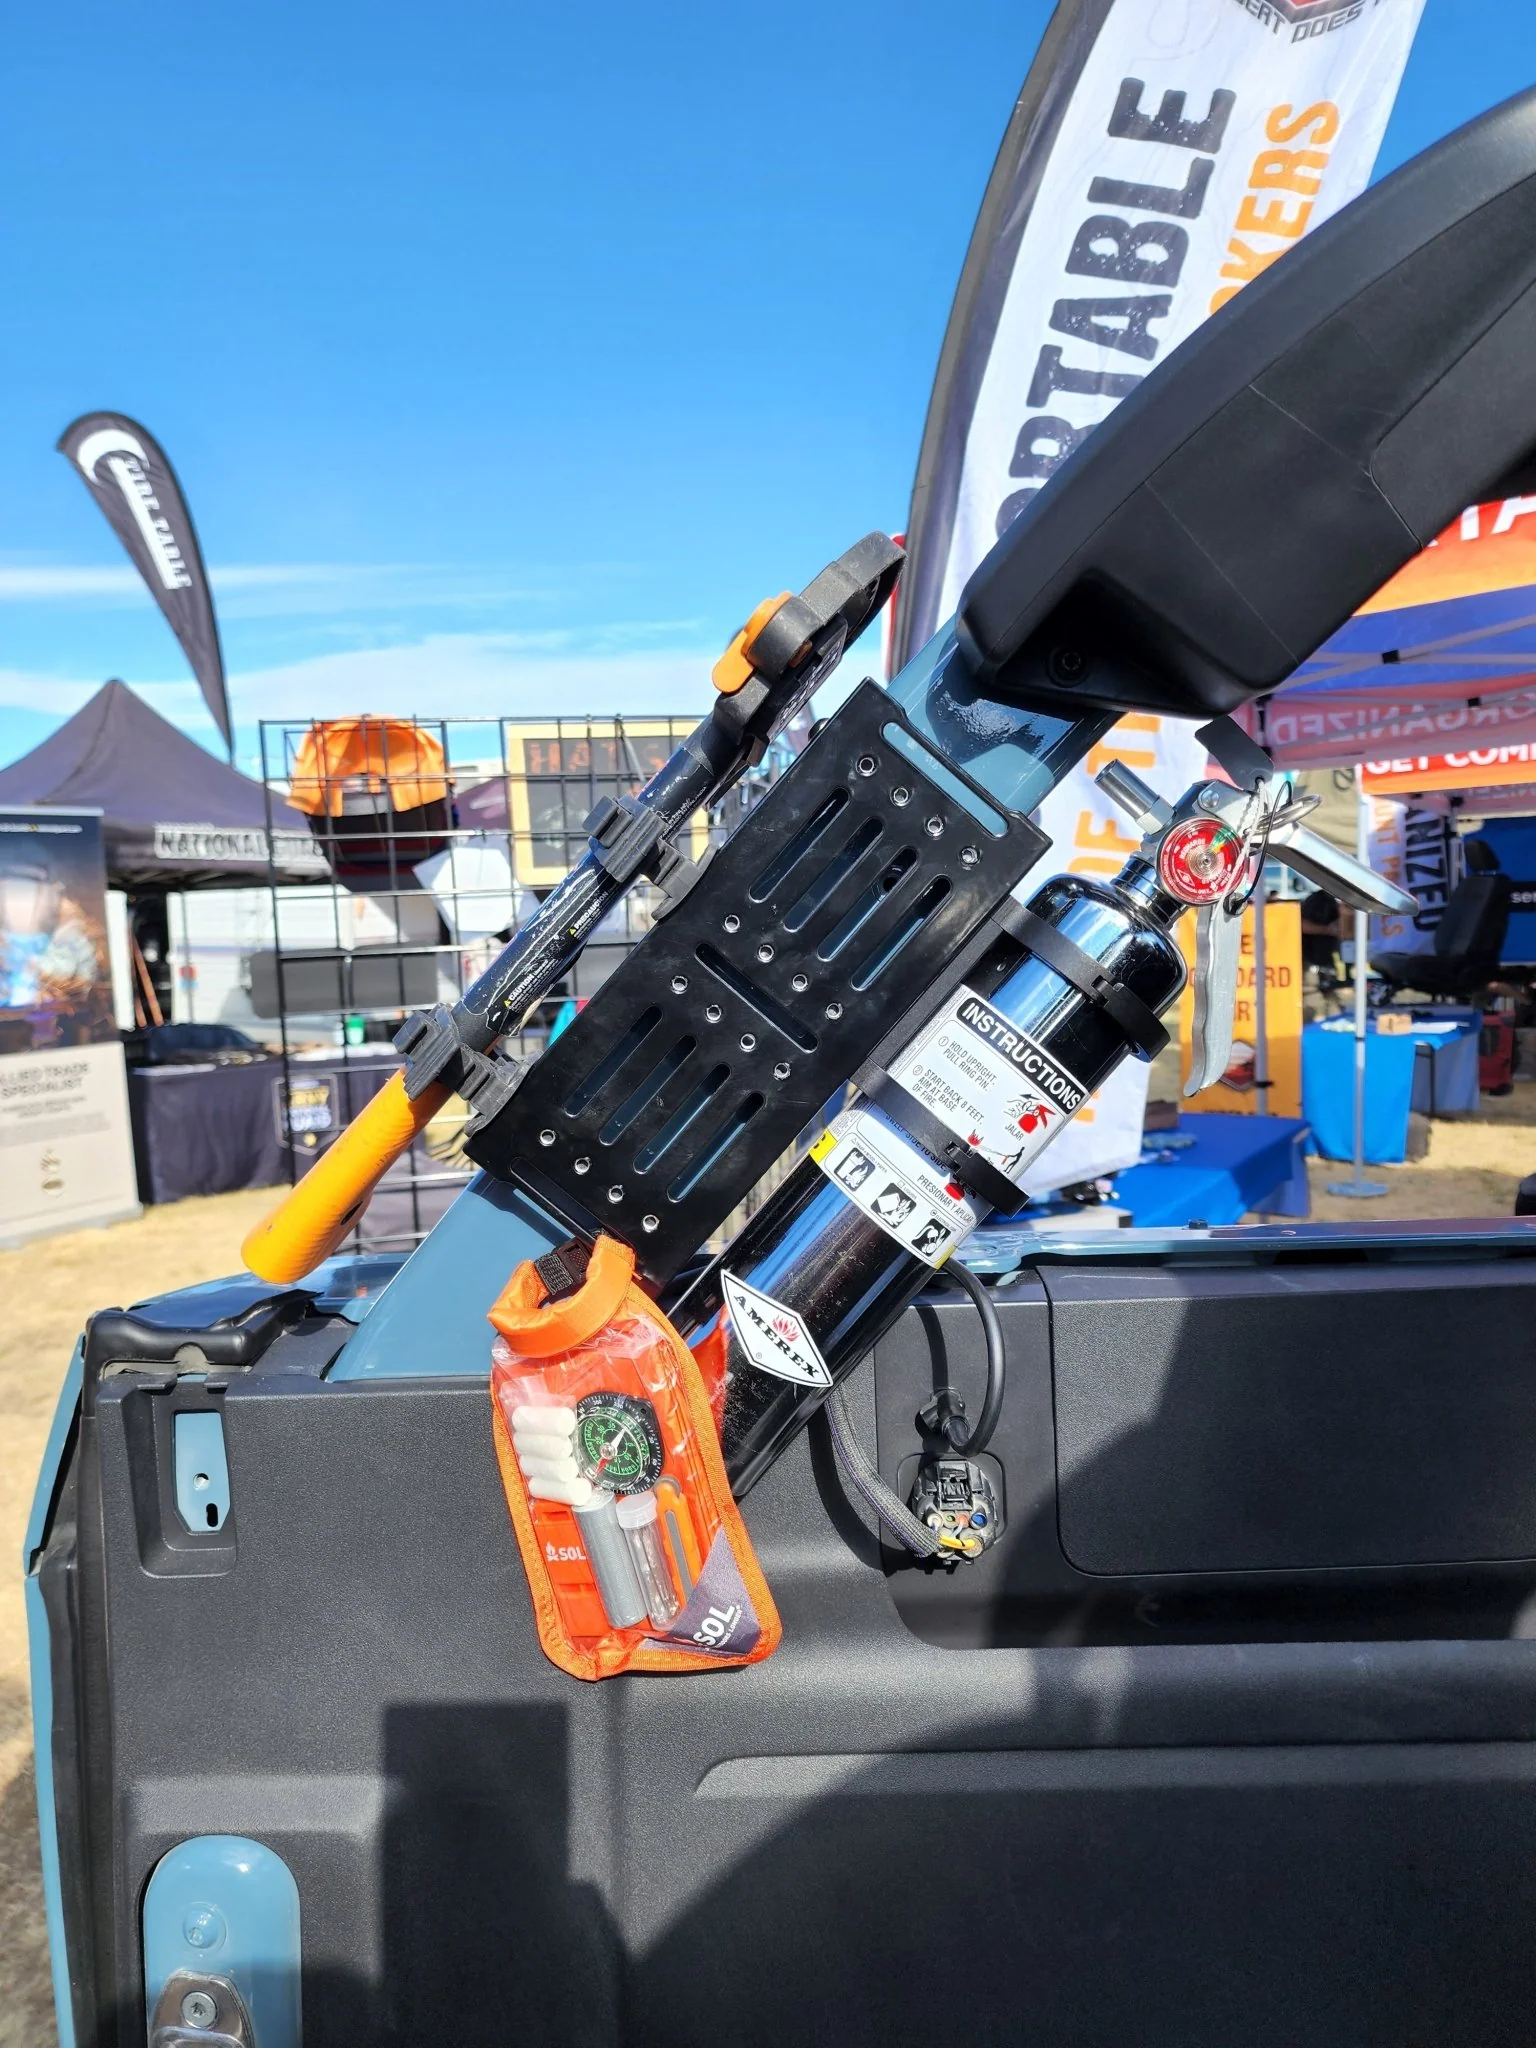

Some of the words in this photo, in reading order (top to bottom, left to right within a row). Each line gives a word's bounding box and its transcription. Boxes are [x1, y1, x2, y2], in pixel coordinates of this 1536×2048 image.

[1234, 0, 1286, 35] EAT
[1290, 5, 1364, 44] DOES
[1207, 100, 1340, 318] KERS
[995, 77, 1237, 541] RTABLE
[508, 972, 534, 1001] CAUTION
[942, 1048, 960, 1065] PULL
[957, 1061, 976, 1078] RING
[974, 1075, 991, 1091] PIN.
[948, 1041, 968, 1059] HOLD
[965, 1055, 998, 1085] UPRIGHT.
[961, 1002, 1081, 1110] INSTRUCTIONS
[911, 1083, 924, 1096] OF
[921, 1092, 938, 1108] FIRE.
[917, 1076, 932, 1090] AIM
[929, 1086, 941, 1098] AT
[938, 1094, 957, 1112] BASE
[923, 1069, 945, 1089] START
[942, 1085, 962, 1104] BACK
[960, 1100, 967, 1109] 8
[964, 1105, 986, 1125] FEET.
[1004, 1122, 1024, 1140] JALAR
[916, 1174, 953, 1207] PRESIONAR
[733, 1295, 820, 1379] AMEREX
[558, 1545, 587, 1561] SOL
[693, 1606, 735, 1646] SOL
